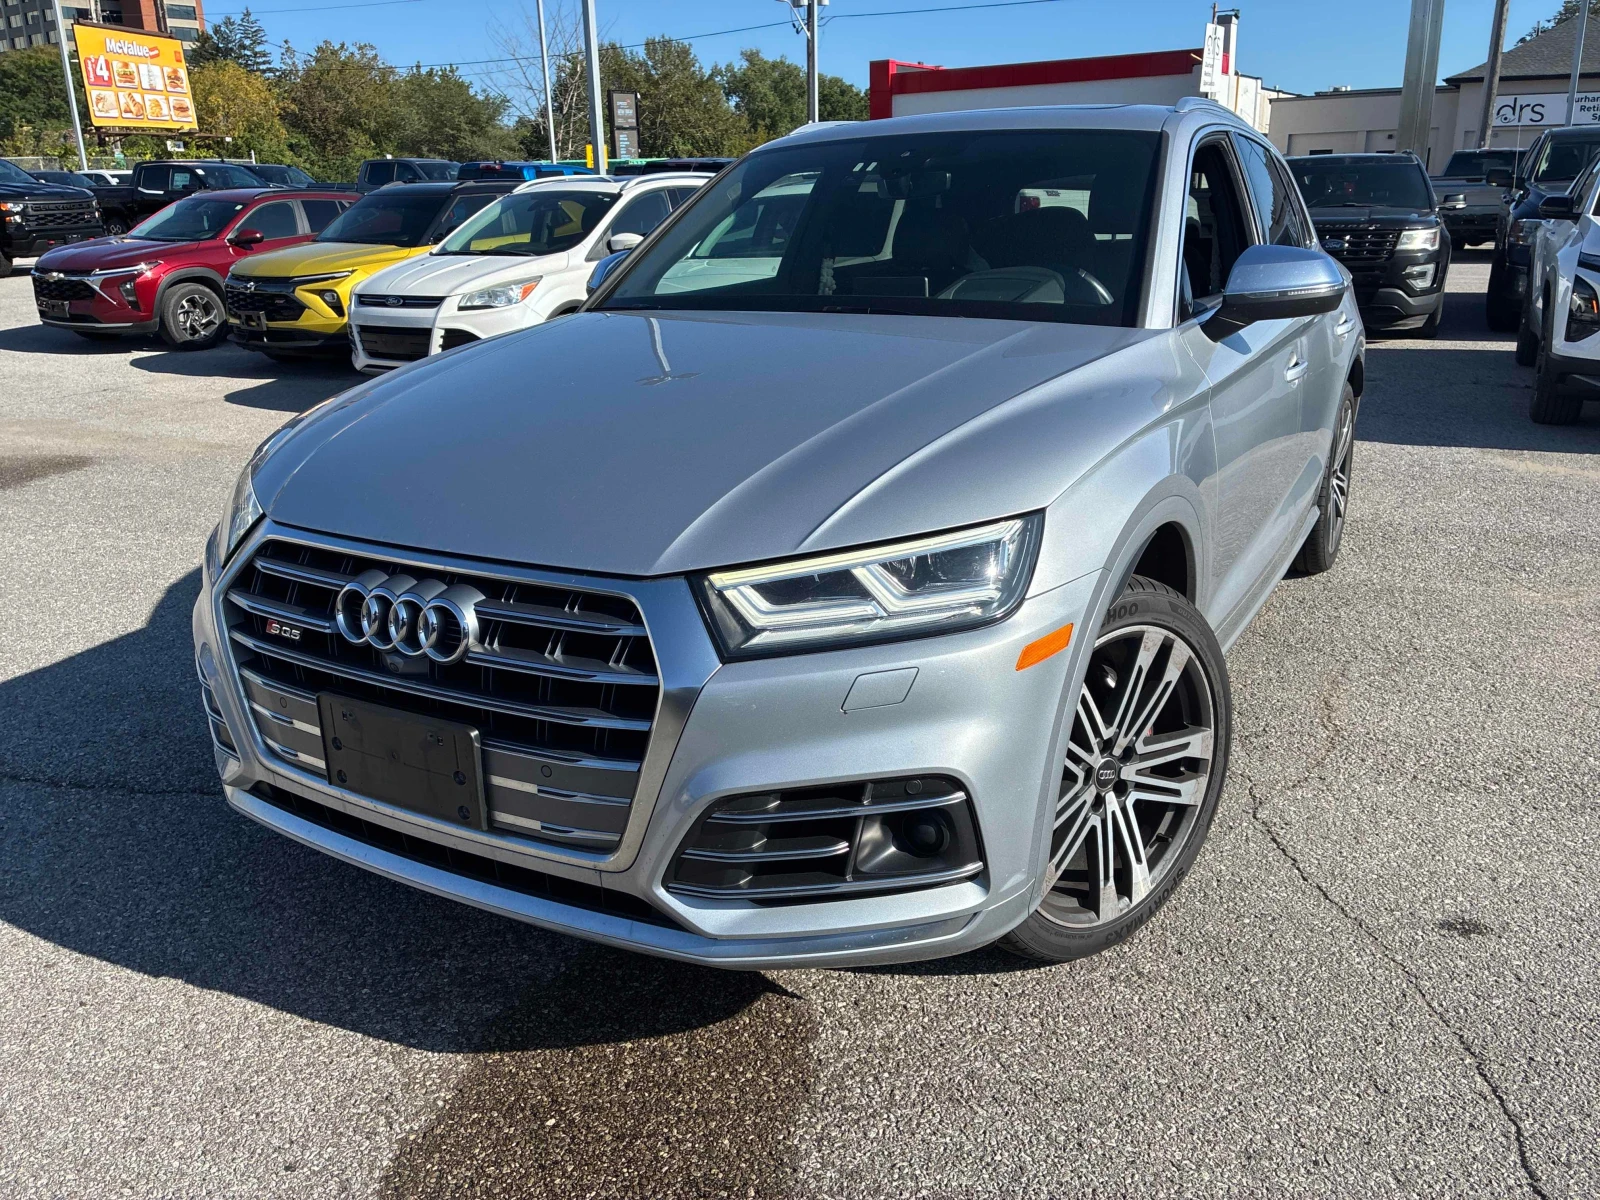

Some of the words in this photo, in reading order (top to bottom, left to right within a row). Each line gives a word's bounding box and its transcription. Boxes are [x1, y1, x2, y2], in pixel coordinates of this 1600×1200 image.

[105, 37, 149, 58] McValue
[1566, 95, 1600, 104] urha
[1579, 104, 1600, 112] Reti
[1496, 97, 1545, 123] drs
[1324, 241, 1343, 249] Ford
[270, 622, 301, 640] SQ5
[1146, 867, 1185, 919] SPORT
